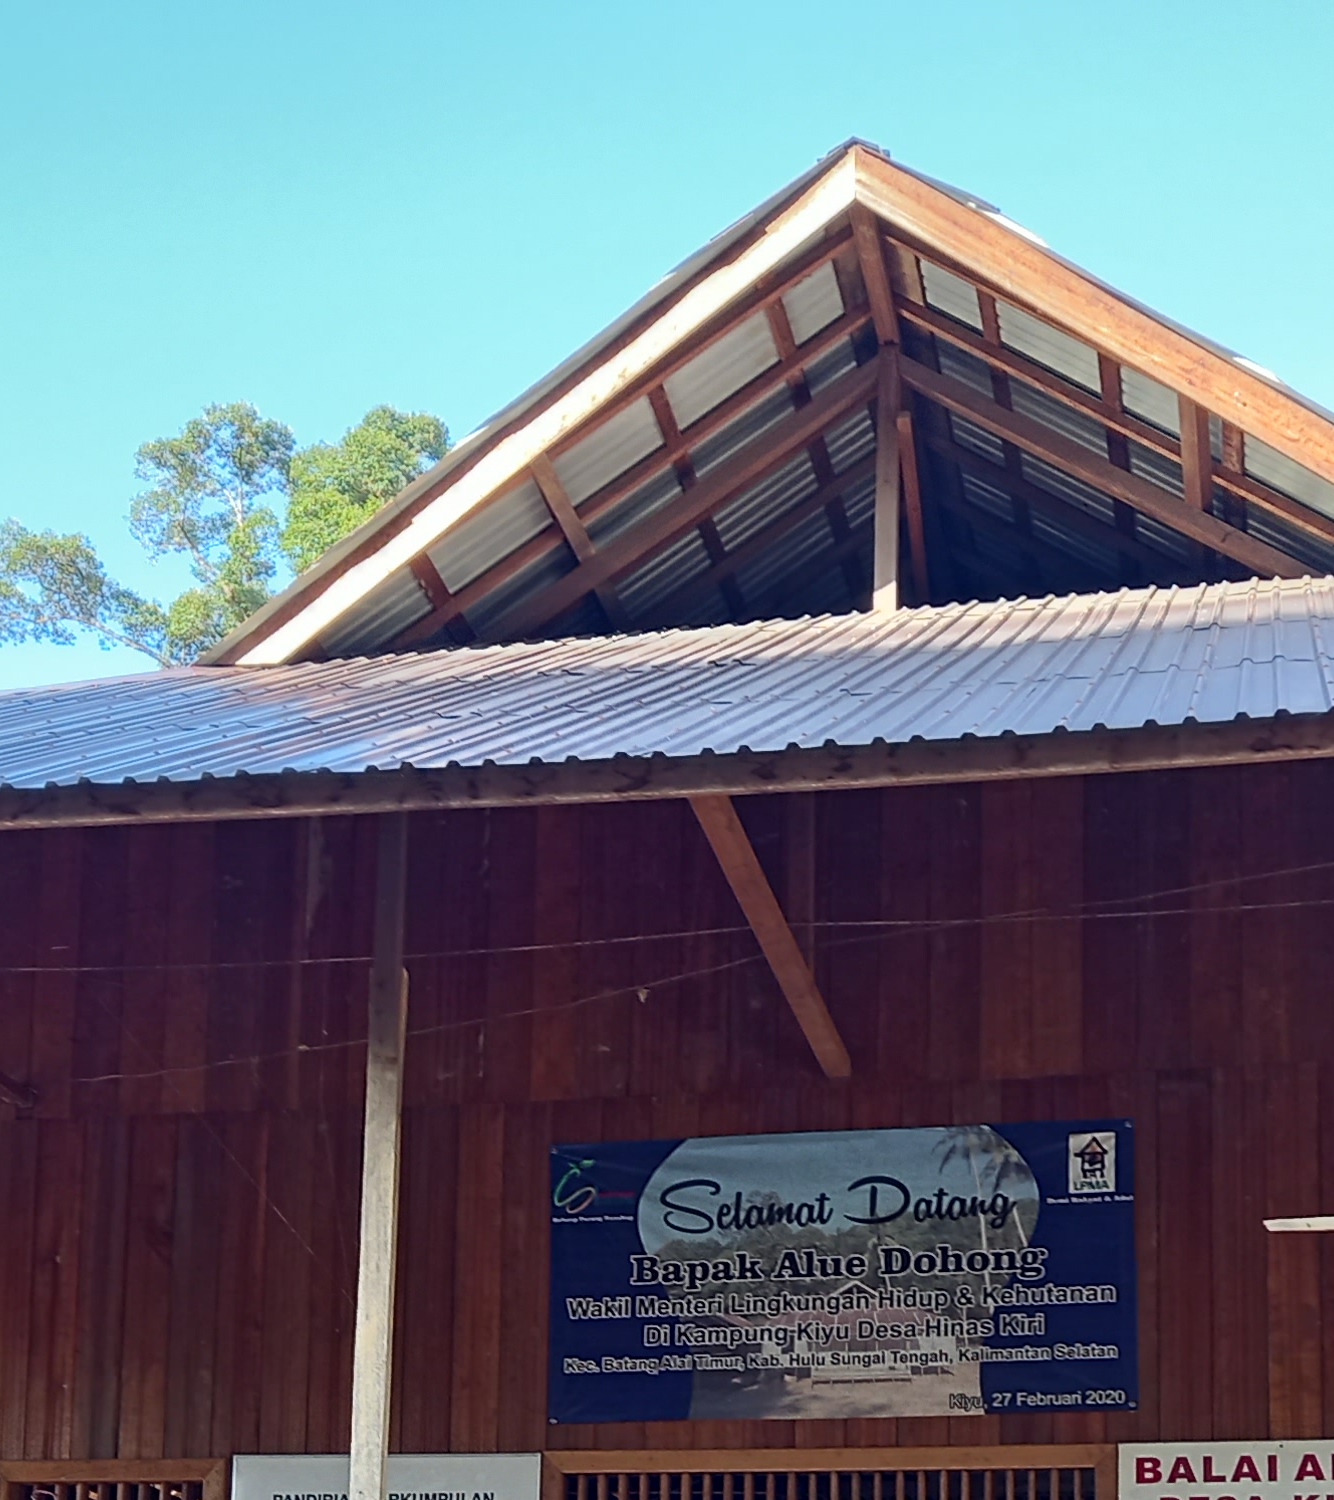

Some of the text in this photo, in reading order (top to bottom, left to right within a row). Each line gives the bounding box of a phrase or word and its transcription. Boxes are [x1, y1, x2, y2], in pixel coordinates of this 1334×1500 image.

[660, 1176, 1017, 1234] Selamat Datang
[630, 1244, 1049, 1291] Bapak Alue Dohong
[566, 1284, 1116, 1319] Wakil Menteri Lingkungan Hidup & Kehutanan
[644, 1313, 1045, 1348] Di Kampung Kiyu Desa Hinas Kiri
[564, 1358, 599, 1373] Kec.
[602, 1356, 659, 1375] Batang
[660, 1355, 692, 1371] Alai
[748, 1353, 784, 1369] Kab.
[788, 1352, 826, 1367] Hulu
[829, 1350, 886, 1368] Sungai
[889, 1349, 953, 1367] Tengah,
[958, 1346, 1051, 1362] Kalimantan
[1054, 1344, 1118, 1360] Selatan
[949, 1390, 1125, 1410] Kiyu, 27 Februari 2020
[1135, 1454, 1278, 1484] BALAI
